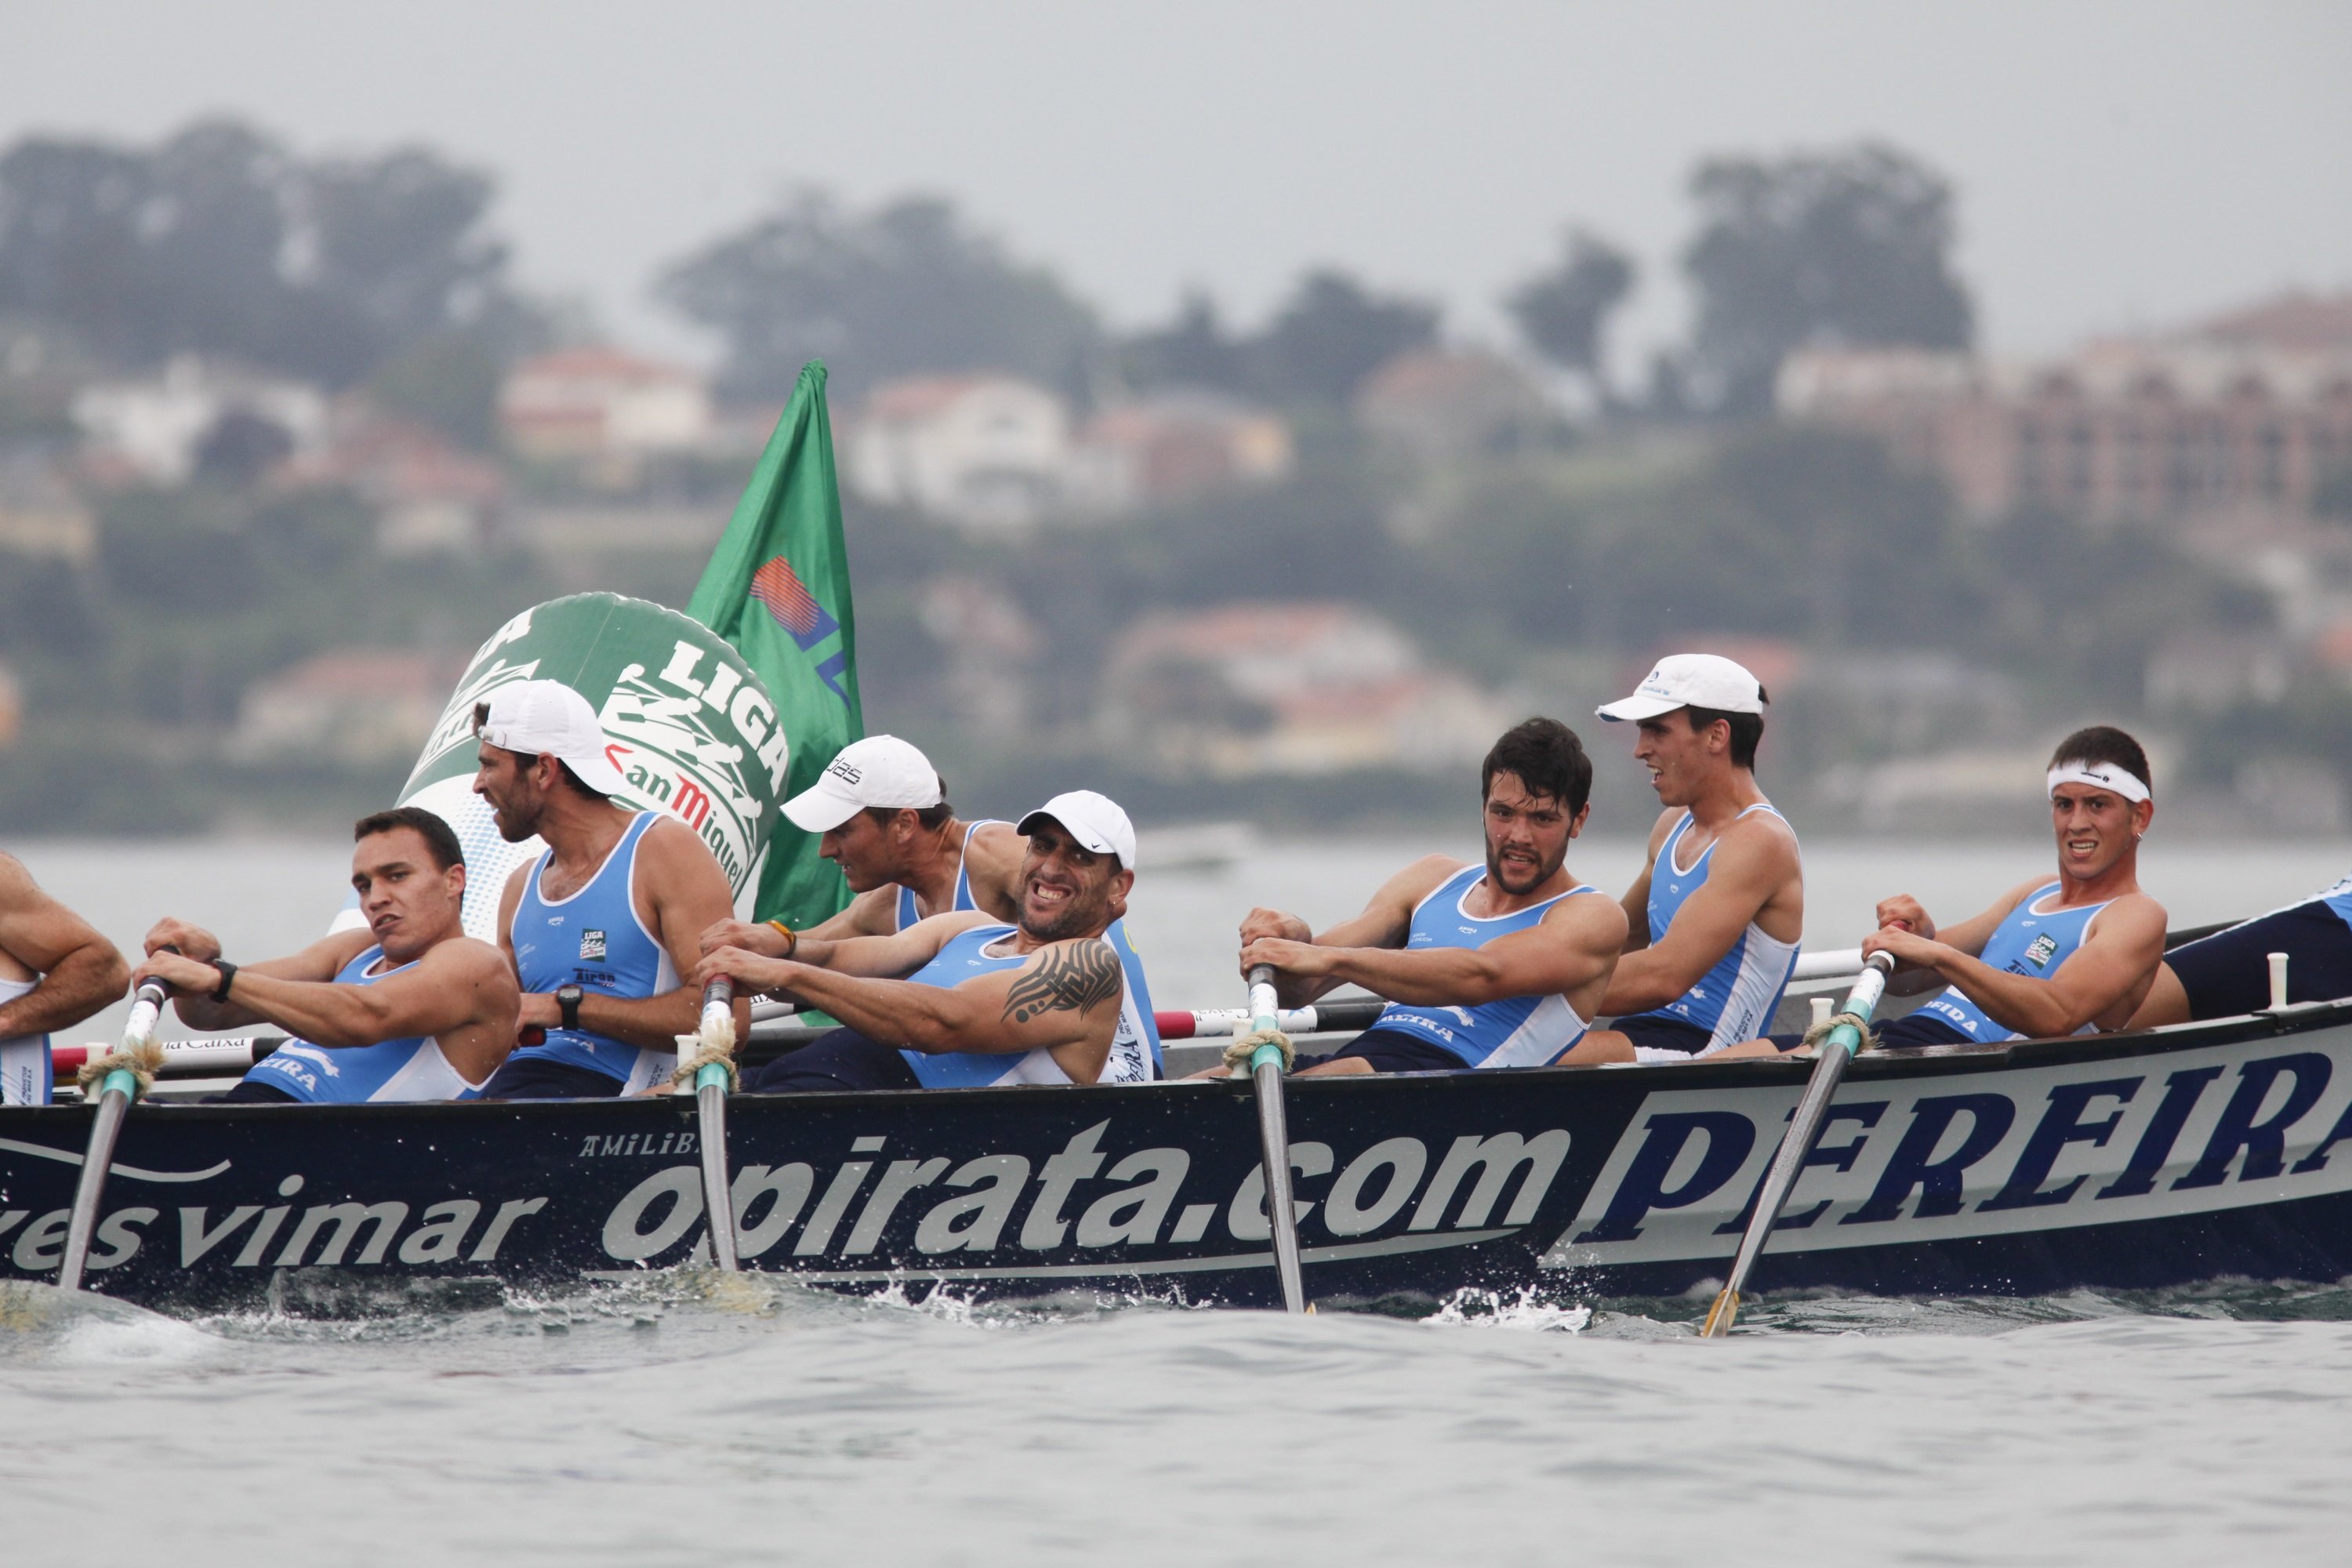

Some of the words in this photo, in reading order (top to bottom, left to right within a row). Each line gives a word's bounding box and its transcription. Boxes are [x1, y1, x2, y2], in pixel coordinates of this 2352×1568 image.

[659, 640, 789, 798] LIGA
[584, 931, 604, 940] LIGA
[179, 1174, 549, 1269] vimar
[602, 1118, 1571, 1261] opirata.com
